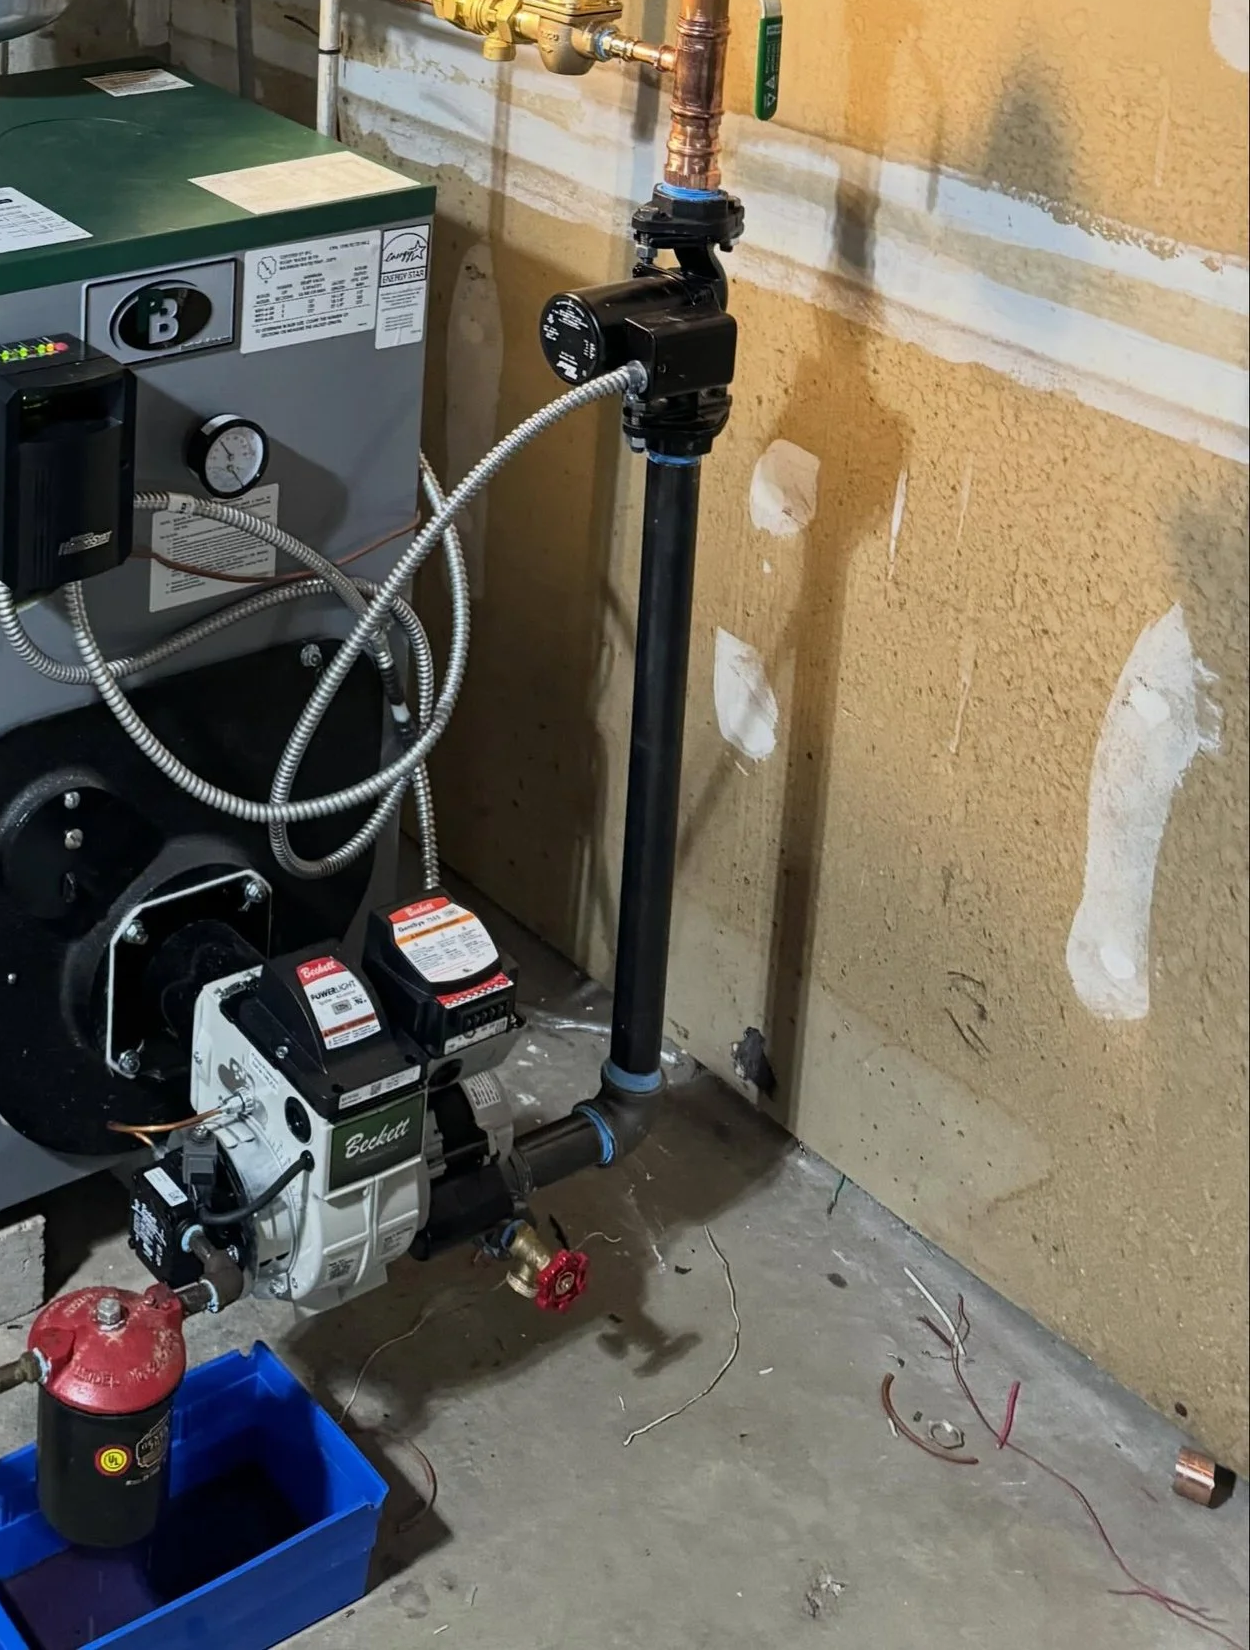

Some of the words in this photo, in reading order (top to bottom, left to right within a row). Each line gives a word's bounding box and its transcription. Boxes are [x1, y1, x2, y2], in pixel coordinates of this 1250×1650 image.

[382, 272, 408, 284] ENERGY
[408, 269, 425, 280] STAR
[300, 961, 337, 979] Beckett
[345, 1117, 410, 1159] Beckett
